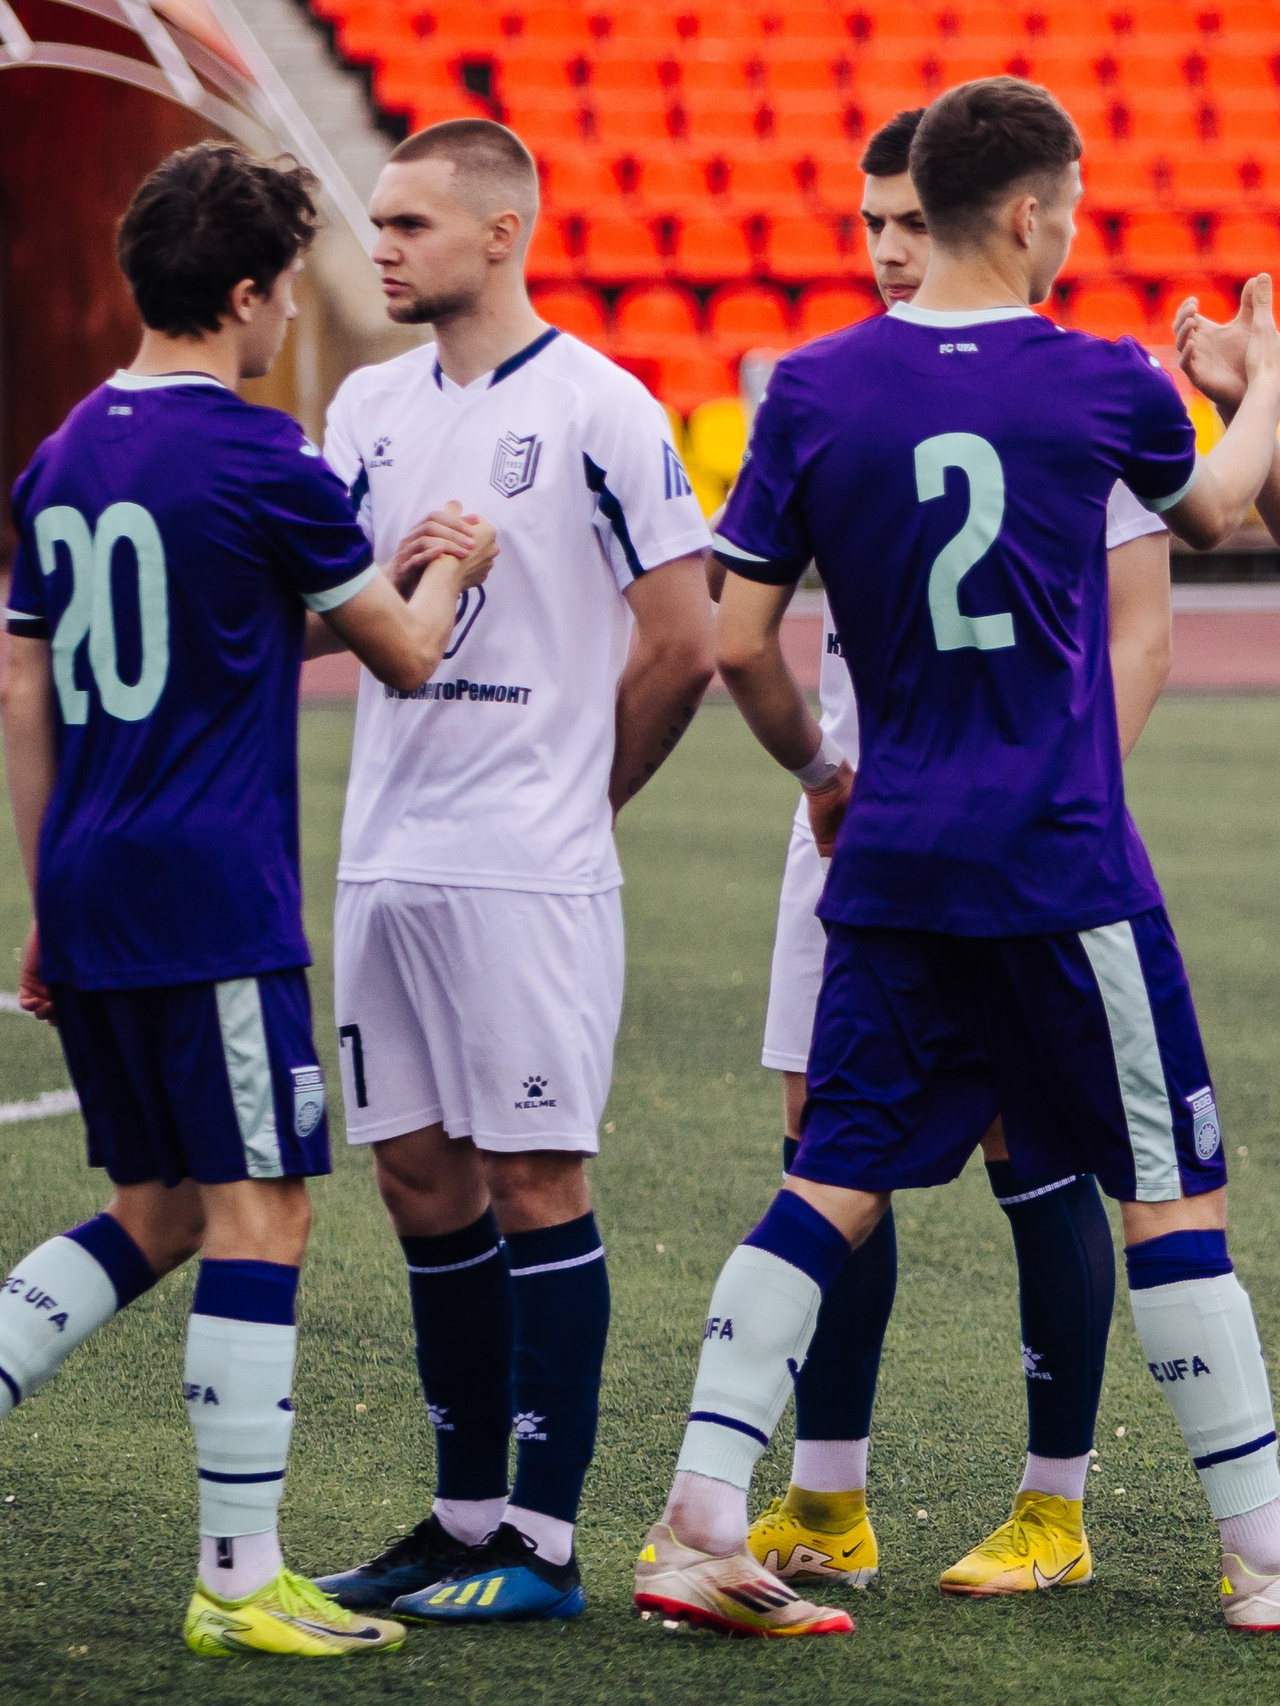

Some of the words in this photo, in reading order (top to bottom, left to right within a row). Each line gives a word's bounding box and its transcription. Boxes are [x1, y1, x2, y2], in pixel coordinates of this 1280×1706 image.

[914, 432, 1016, 650] 2
[33, 501, 170, 724] 20
[514, 1099, 557, 1110] KELME
[24, 1286, 70, 1333] UFA
